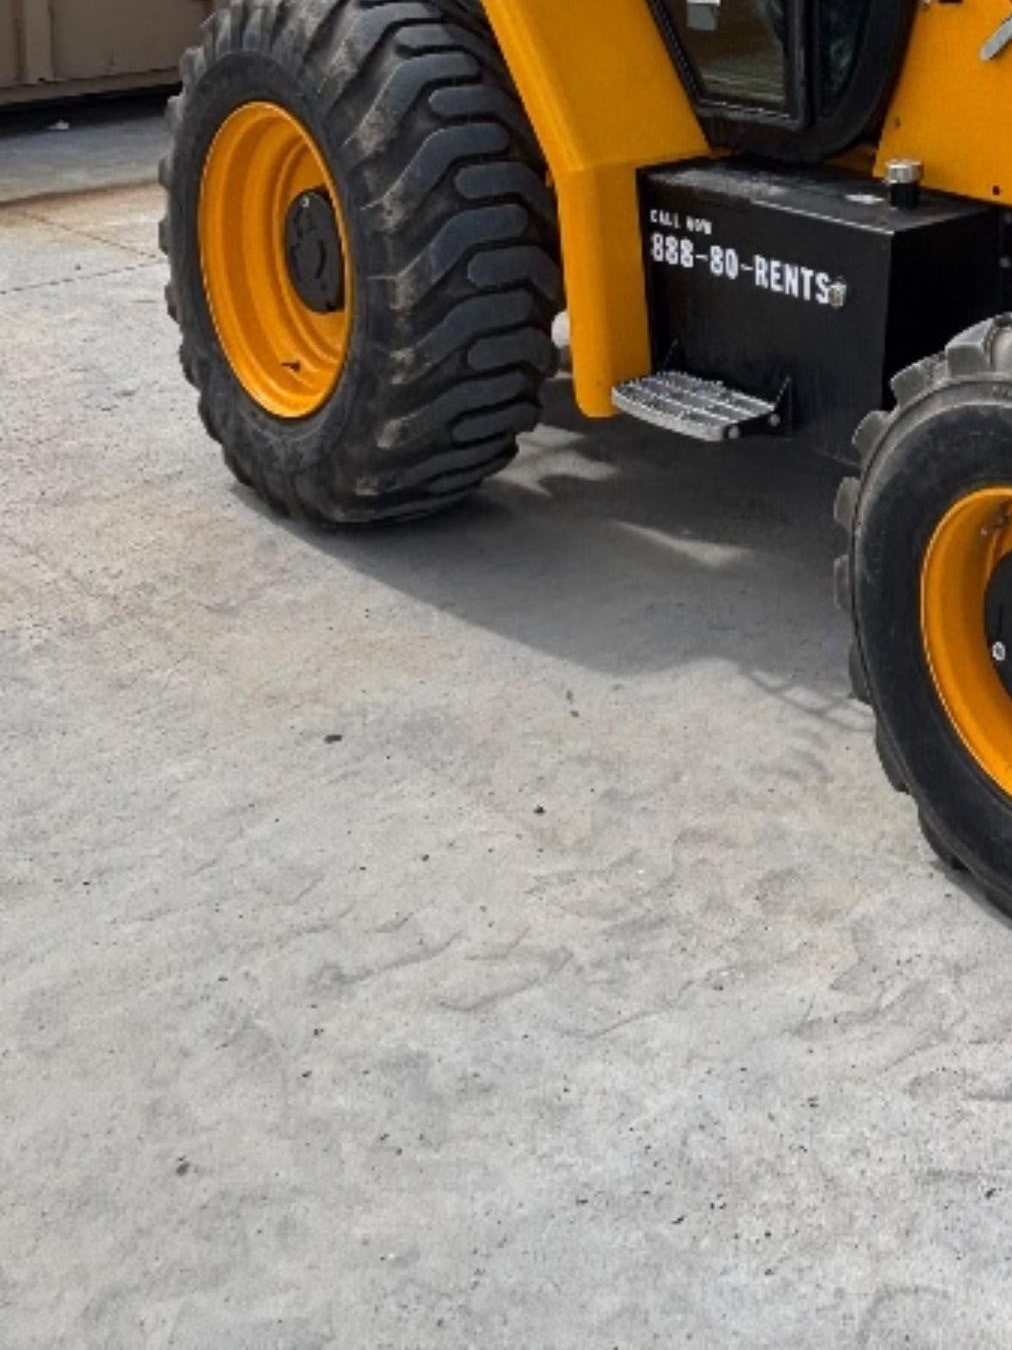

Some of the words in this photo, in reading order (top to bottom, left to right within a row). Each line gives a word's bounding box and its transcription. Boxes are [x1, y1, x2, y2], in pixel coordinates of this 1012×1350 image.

[650, 208, 682, 230] CALL
[685, 215, 713, 236] NOW
[651, 231, 831, 305] 888-80-RENTS
